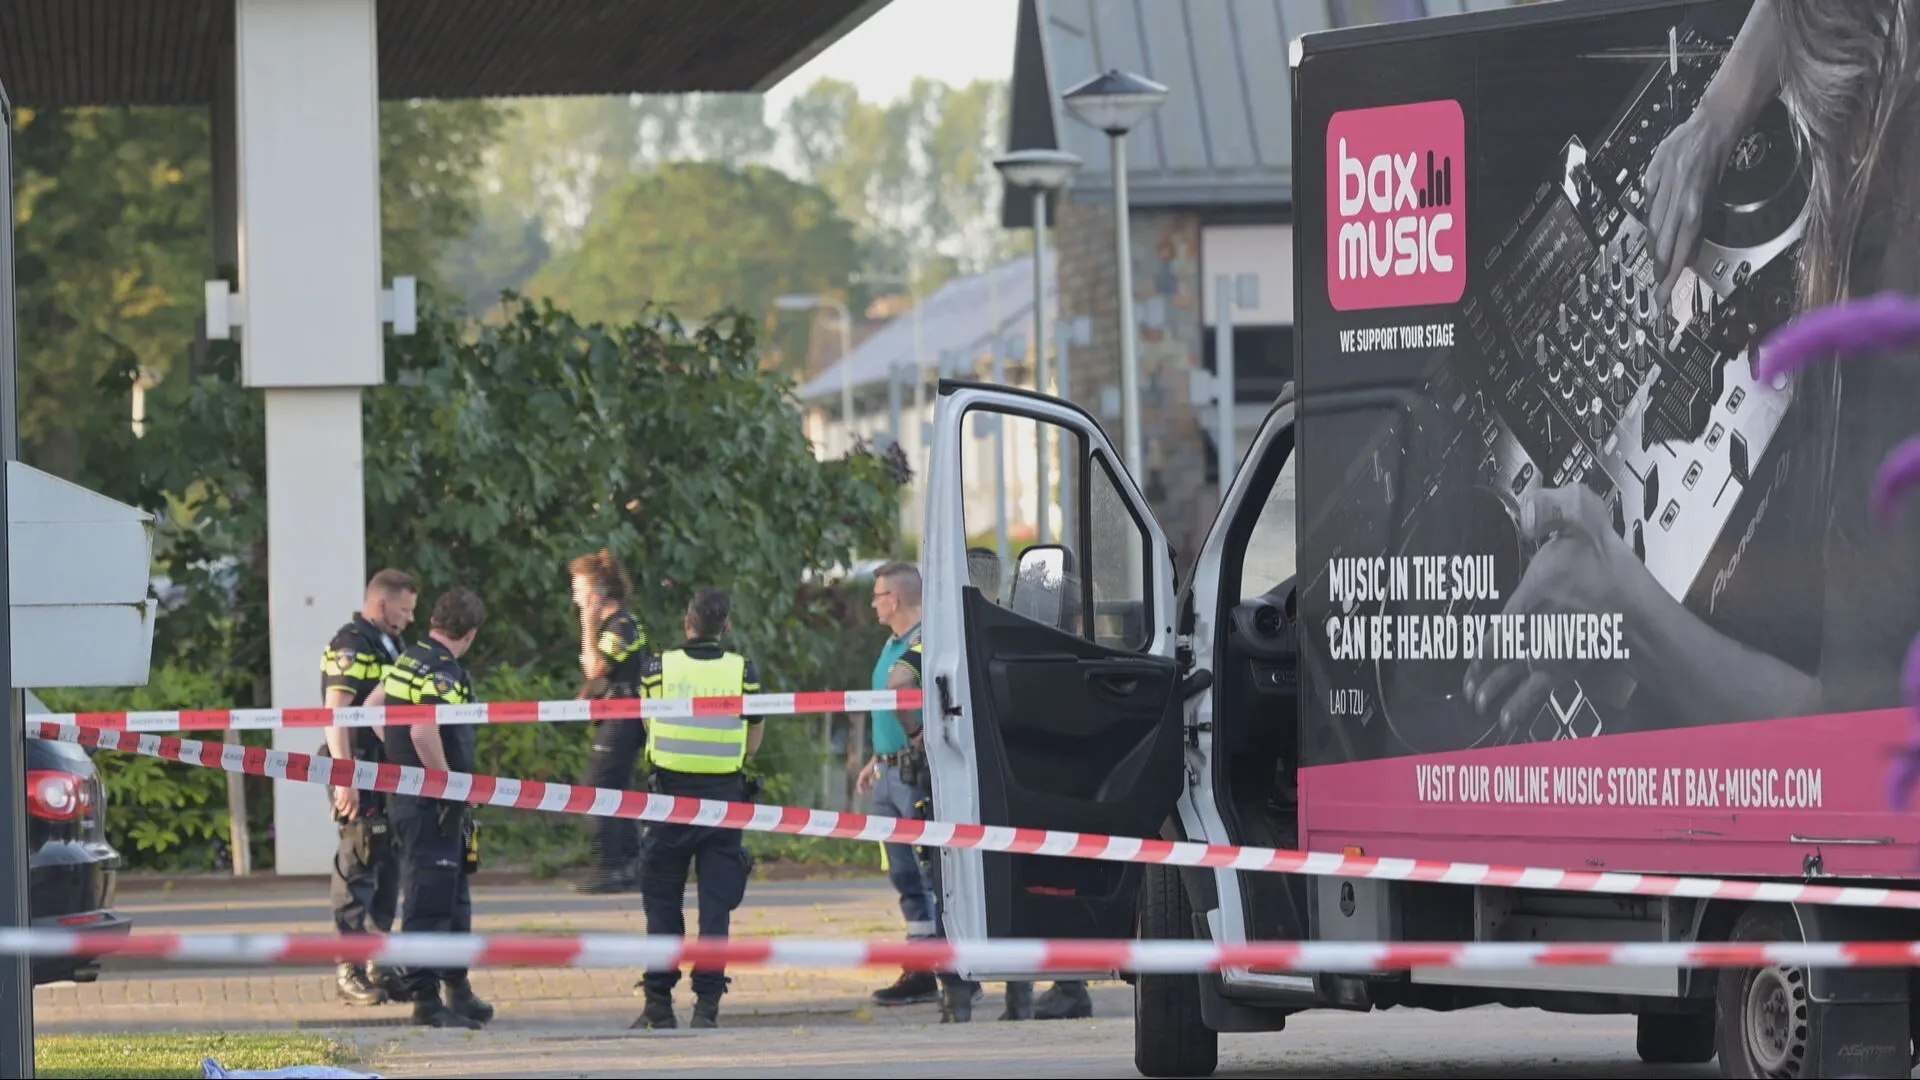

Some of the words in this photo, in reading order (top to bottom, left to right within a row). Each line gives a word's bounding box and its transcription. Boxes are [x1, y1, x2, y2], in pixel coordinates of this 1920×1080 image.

[1339, 137, 1418, 217] bax
[1340, 330, 1356, 352] WE
[1357, 327, 1398, 351] SUPPORT
[1400, 325, 1425, 348] YOUR
[1426, 323, 1455, 347] STAGE
[1709, 484, 1773, 616] Pioneer
[1329, 557, 1386, 602] MUSIC
[1390, 557, 1408, 601] IN
[1413, 556, 1447, 600] THE
[1451, 555, 1499, 600] SOUL
[1329, 616, 1366, 660] CAN
[1371, 616, 1393, 659] BE
[1397, 616, 1458, 659] HEARD
[1463, 615, 1486, 659] BY
[1530, 613, 1630, 659] UNIVERSE.
[1330, 689, 1346, 715] LAO
[1349, 689, 1364, 715] TZU
[1416, 765, 1455, 802] VISIT
[1459, 765, 1490, 802] OUR
[1494, 766, 1549, 803] ONLINE
[1553, 767, 1604, 804] MUSIC
[1607, 767, 1658, 806] STORE
[1661, 768, 1681, 806] AT
[1686, 768, 1822, 808] BAX-MUSIC.COM
